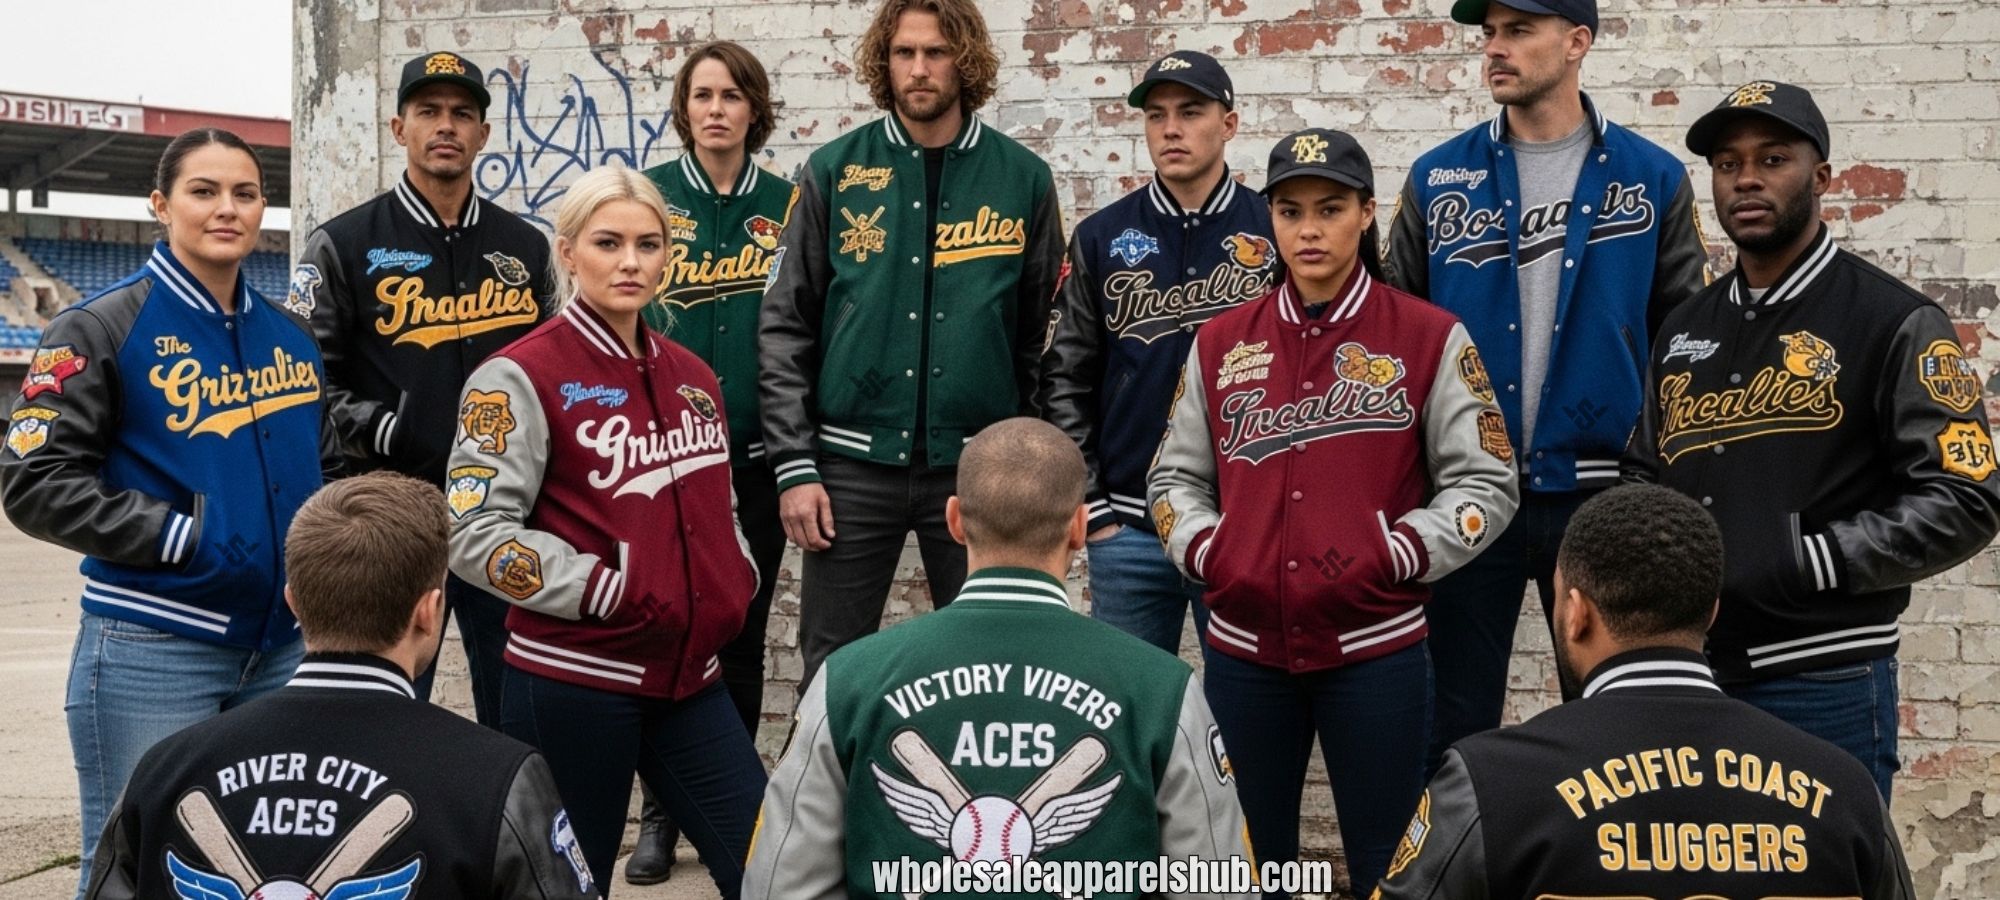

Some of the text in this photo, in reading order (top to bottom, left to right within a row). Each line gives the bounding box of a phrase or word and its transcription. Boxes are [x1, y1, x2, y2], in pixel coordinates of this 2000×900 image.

[154, 335, 193, 357] The
[884, 663, 1122, 730] VICTORY VIPERS
[951, 721, 1056, 767] ACES
[216, 752, 388, 800] RIVER CITY
[1555, 746, 1832, 820] PACIFIC COAST
[246, 797, 338, 837] ACES
[1597, 822, 1808, 873] SLUGGERS
